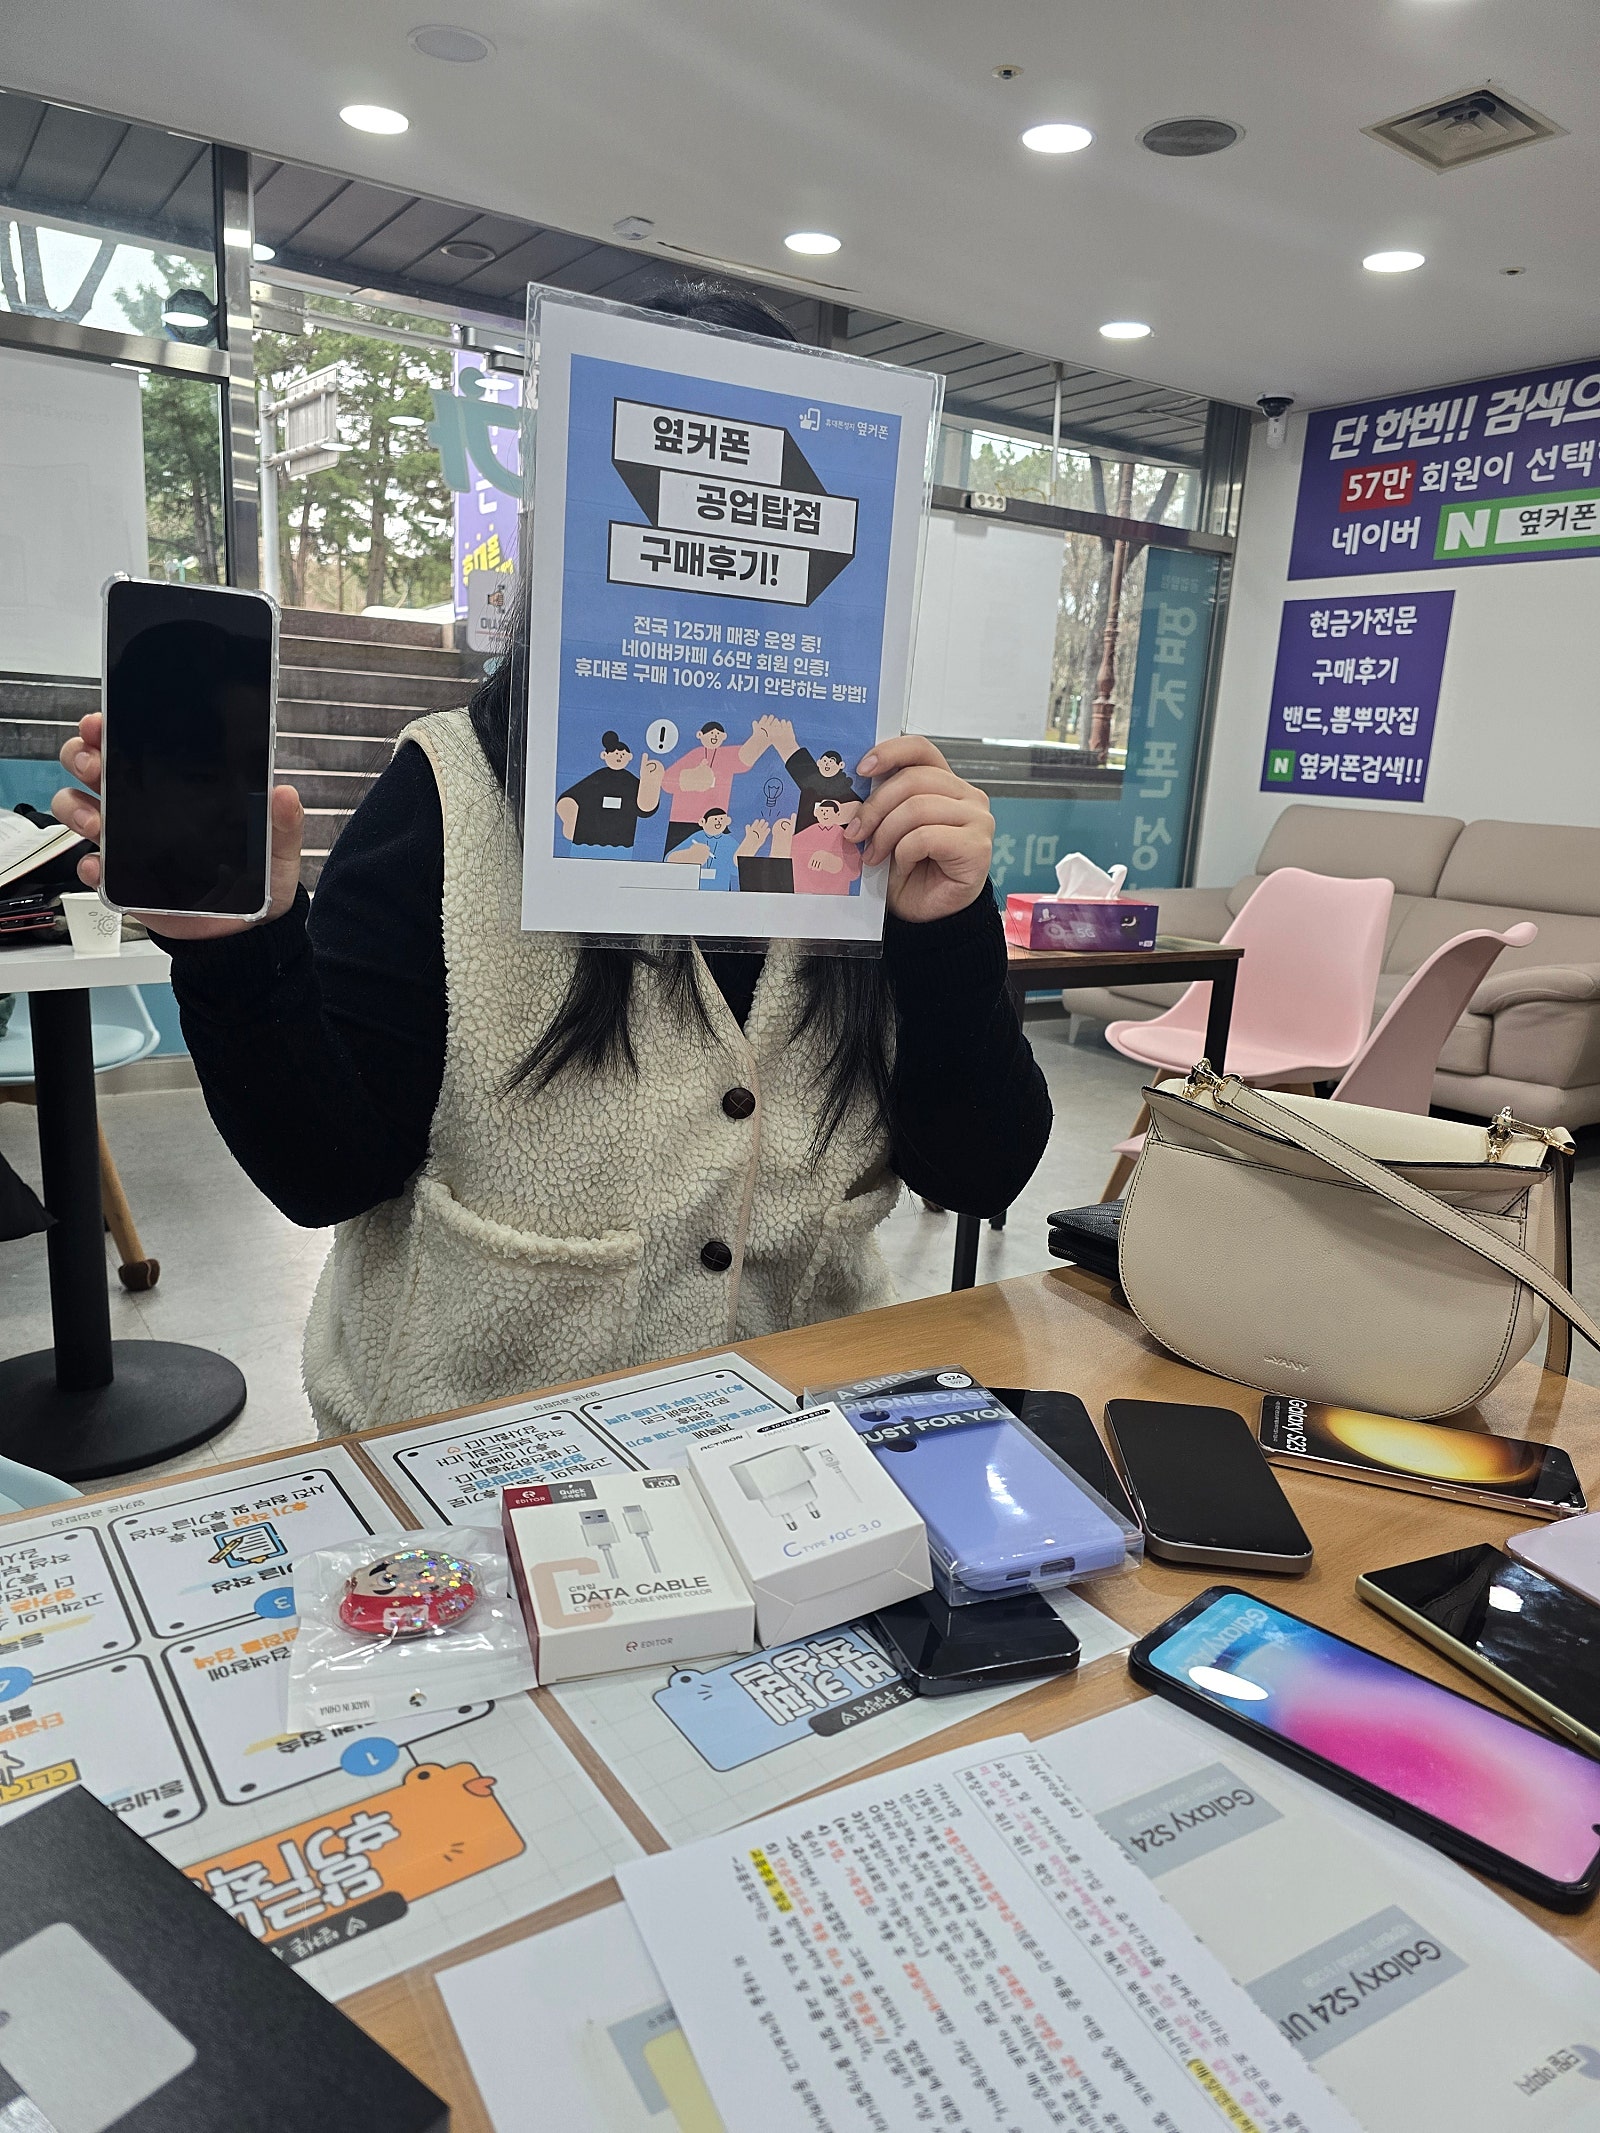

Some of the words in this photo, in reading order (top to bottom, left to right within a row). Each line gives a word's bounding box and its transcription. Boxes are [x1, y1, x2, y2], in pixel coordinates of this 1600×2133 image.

[857, 421, 889, 440] 옆커폰
[1329, 415, 1367, 461] 단
[1371, 395, 1478, 455] 한번!!
[653, 414, 750, 467] 옆커폰
[1347, 467, 1412, 502] 57만
[1419, 452, 1514, 493] 회원이
[1526, 439, 1600, 482] 선택
[696, 483, 822, 535] 공업탑점
[1331, 516, 1422, 556] 네이버
[1518, 503, 1596, 537] 옆커폰
[639, 534, 779, 587] 구매후기!
[1309, 605, 1417, 638] 현금가전문
[633, 615, 668, 638] 전국
[673, 619, 722, 644] 125개
[726, 624, 759, 649] 매장
[764, 628, 795, 652] 운영
[800, 631, 821, 654] 중!
[621, 638, 708, 668] 네이버카페
[712, 646, 752, 672] 66만
[756, 651, 788, 675] 회원
[793, 653, 829, 678] 인증!
[1311, 657, 1399, 685] 구매후기
[574, 657, 628, 684] 휴대폰
[633, 664, 667, 686] 구매
[673, 668, 722, 690] 100%
[726, 673, 759, 695] 사기
[763, 675, 826, 701] 안당하는
[831, 681, 867, 705] 방법!
[1282, 706, 1419, 737] 밴드,뽐뿌맛집
[1299, 752, 1423, 784] 옆커폰검색!!
[725, 1384, 745, 1395] 후기
[836, 1390, 855, 1400] A
[856, 1369, 928, 1394] SIMPLE
[673, 1396, 696, 1407] 첨부
[696, 1390, 719, 1400] 사진
[704, 1396, 730, 1408] 문자
[840, 1391, 929, 1414] PHONE
[932, 1390, 993, 1405] CASE
[604, 1413, 630, 1426] 입력
[639, 1414, 666, 1425] 드린
[666, 1403, 703, 1417] 전송해
[674, 1411, 713, 1425] 입력후
[1282, 1399, 1307, 1435] Galaxy
[692, 1423, 735, 1439] 제목에
[919, 1414, 965, 1433] FOR
[464, 1425, 540, 1449] 감사합니다
[535, 1429, 566, 1441] 작성
[654, 1430, 677, 1440] 구매
[1286, 1433, 1307, 1453] S23
[436, 1438, 532, 1467] 부탁드립니다!
[519, 1442, 549, 1456] 후기
[563, 1444, 581, 1454] 더
[449, 1449, 562, 1484] 발전하겠습니다.
[469, 1452, 516, 1469] 이쁘게
[540, 1453, 587, 1472] 옆커폰
[551, 1456, 612, 1480] 고객님의
[459, 1466, 538, 1493] 공업탑점은
[504, 1474, 547, 1488] 소중
[649, 1479, 678, 1488] 1.0M
[291, 1484, 325, 1500] 사진
[448, 1489, 498, 1508] 후기로
[515, 1496, 546, 1505] EDITOR
[559, 1488, 586, 1496] Quick
[230, 1503, 250, 1515] 및
[253, 1494, 289, 1510] 첨부
[272, 1501, 309, 1516] 후기
[172, 1511, 227, 1531] 후기글
[192, 1521, 229, 1537] 클릭
[232, 1512, 271, 1527] 작성
[130, 1526, 169, 1542] 작성
[167, 1532, 187, 1544] 후
[803, 1540, 827, 1552] TYPE
[835, 1529, 856, 1542] QC
[858, 1520, 881, 1533] 3.0
[29, 1554, 71, 1570] 작성
[55, 1575, 75, 1589] 더
[211, 1575, 256, 1594] 작성
[568, 1583, 596, 1592] C타입
[571, 1590, 630, 1605] DATA
[636, 1576, 709, 1596] CABLE
[0, 1583, 47, 1602] 발전
[582, 1603, 601, 1612] TYPE
[606, 1600, 626, 1609] DATA
[628, 1596, 655, 1606] CABLE
[656, 1592, 682, 1602] WHITE
[684, 1588, 712, 1598] COLOR
[18, 1593, 104, 1625] 고객님의
[274, 1596, 291, 1609] 3
[641, 1637, 673, 1649] EDITOR
[193, 1643, 237, 1670] 검색
[208, 1647, 291, 1682] 검색창에
[320, 1704, 341, 1715] CHINA
[341, 1703, 349, 1712] IN
[349, 1700, 370, 1710] MADE
[275, 1729, 327, 1753] 접속
[365, 1752, 379, 1766] 1
[108, 1780, 184, 1813] 동네업
[1171, 1788, 1255, 1833] Galaxy
[1130, 1824, 1177, 1854] S24
[1346, 1938, 1441, 2001] Galaxy
[1306, 1985, 1359, 2025] S24
